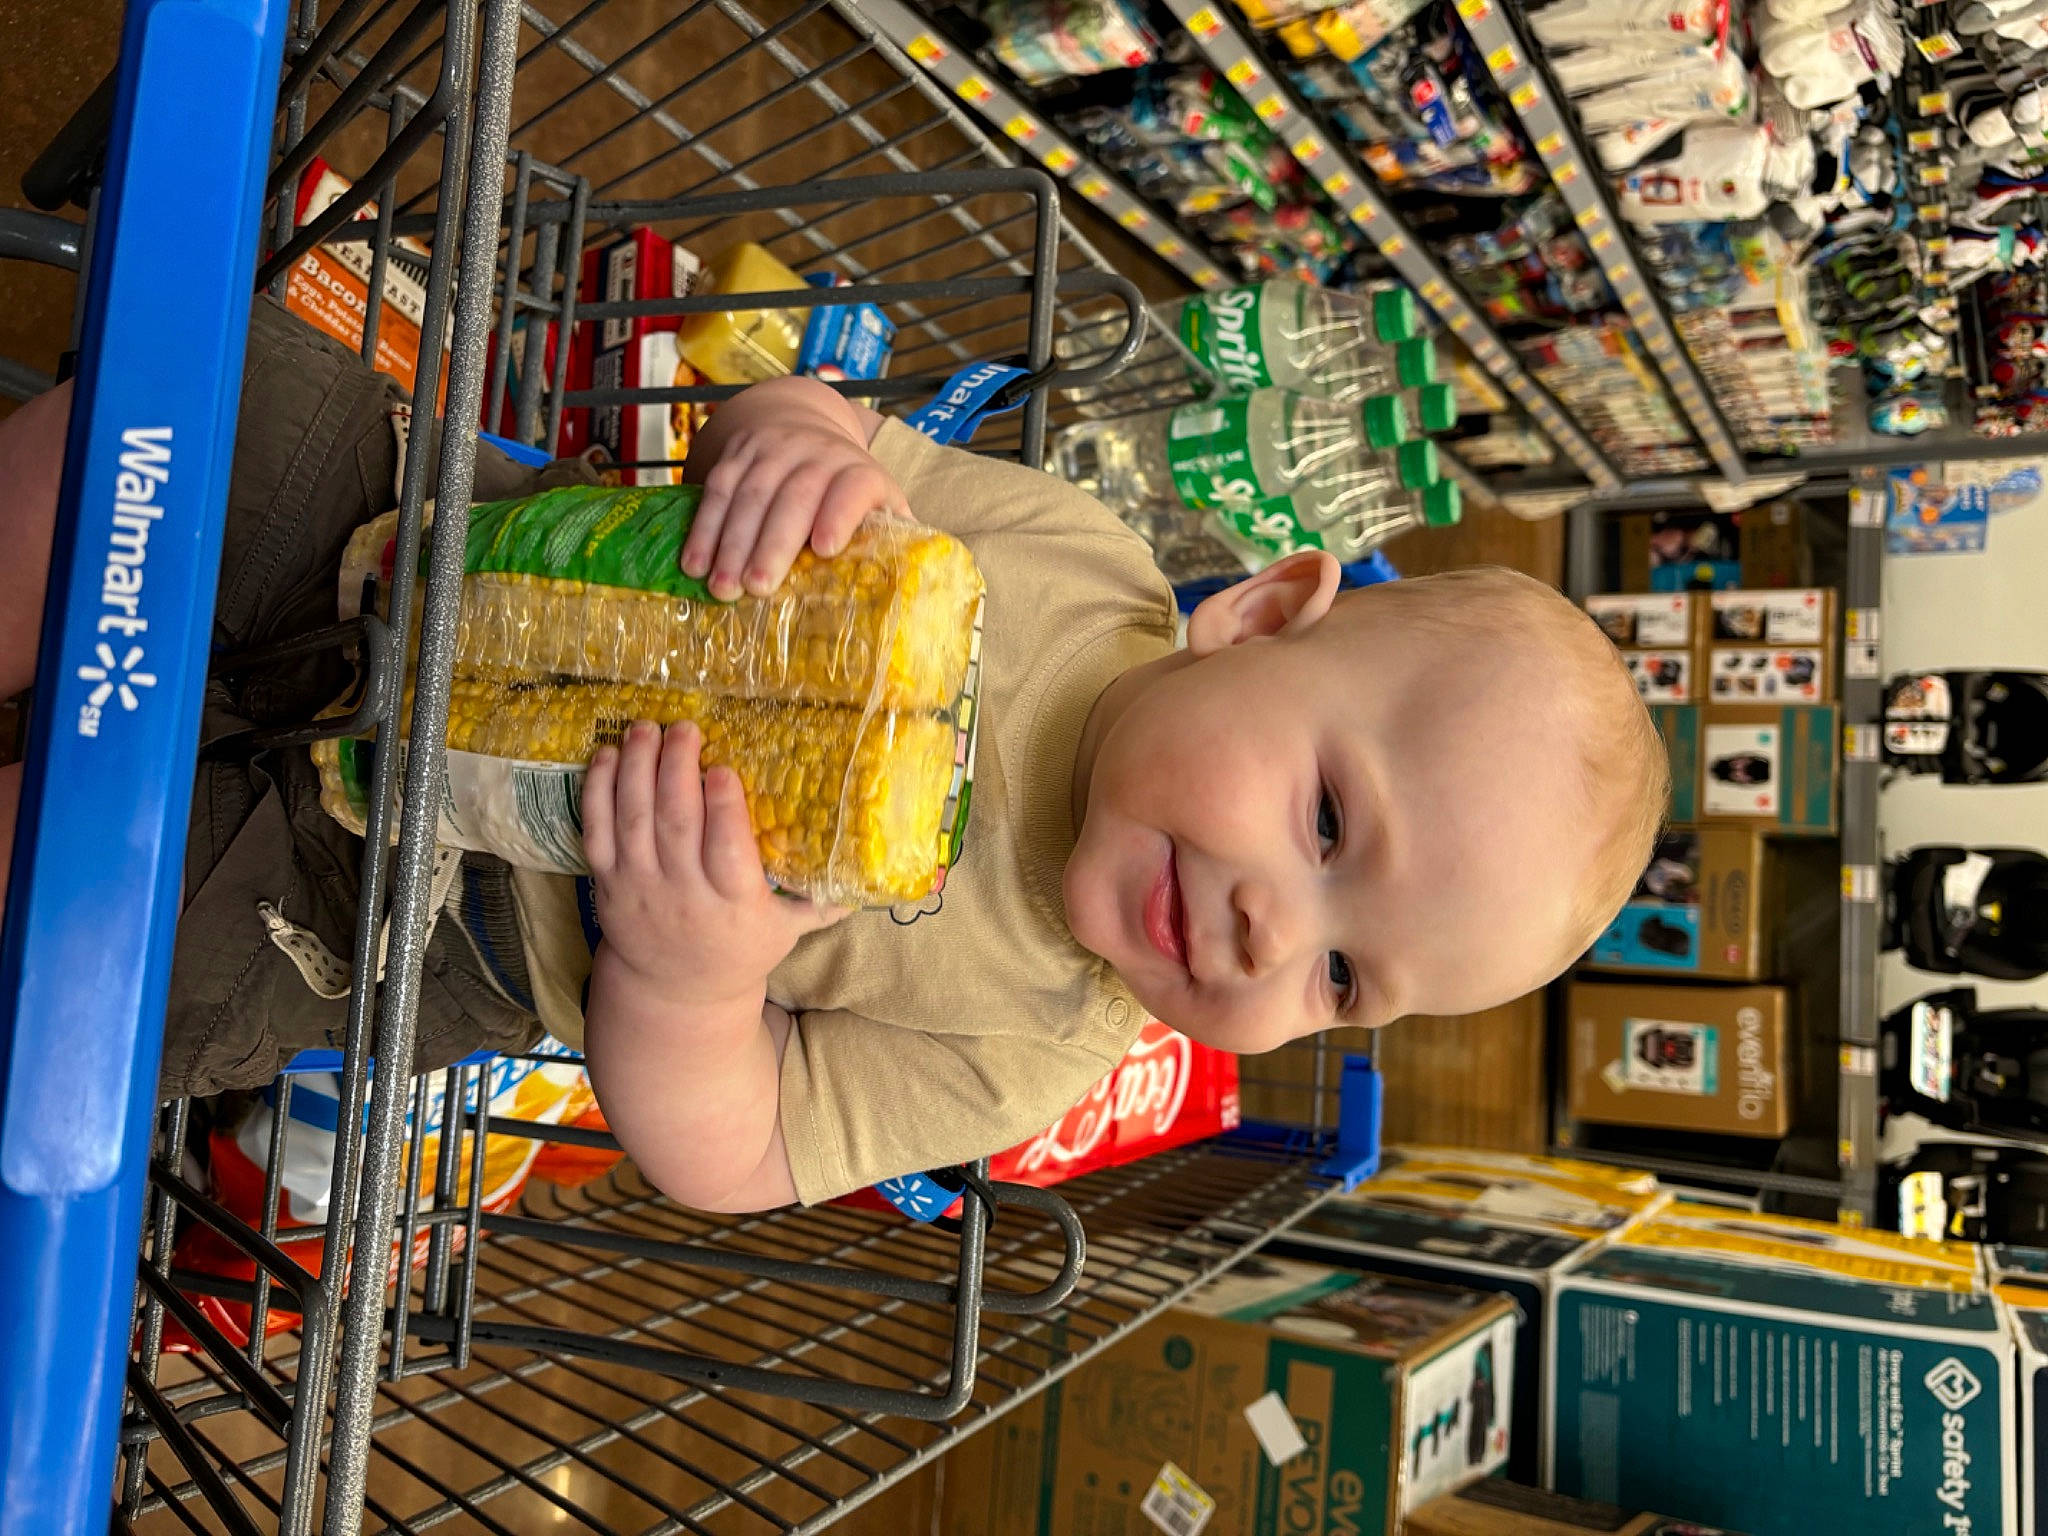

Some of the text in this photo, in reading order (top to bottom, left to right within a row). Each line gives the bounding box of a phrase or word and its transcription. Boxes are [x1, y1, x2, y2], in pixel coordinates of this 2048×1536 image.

[927, 363, 1009, 421] lmart
[97, 426, 173, 637] Walmart
[1737, 1007, 1773, 1118] evenflo
[1283, 1415, 1323, 1536] REVO
[1936, 1412, 1971, 1509] safety
